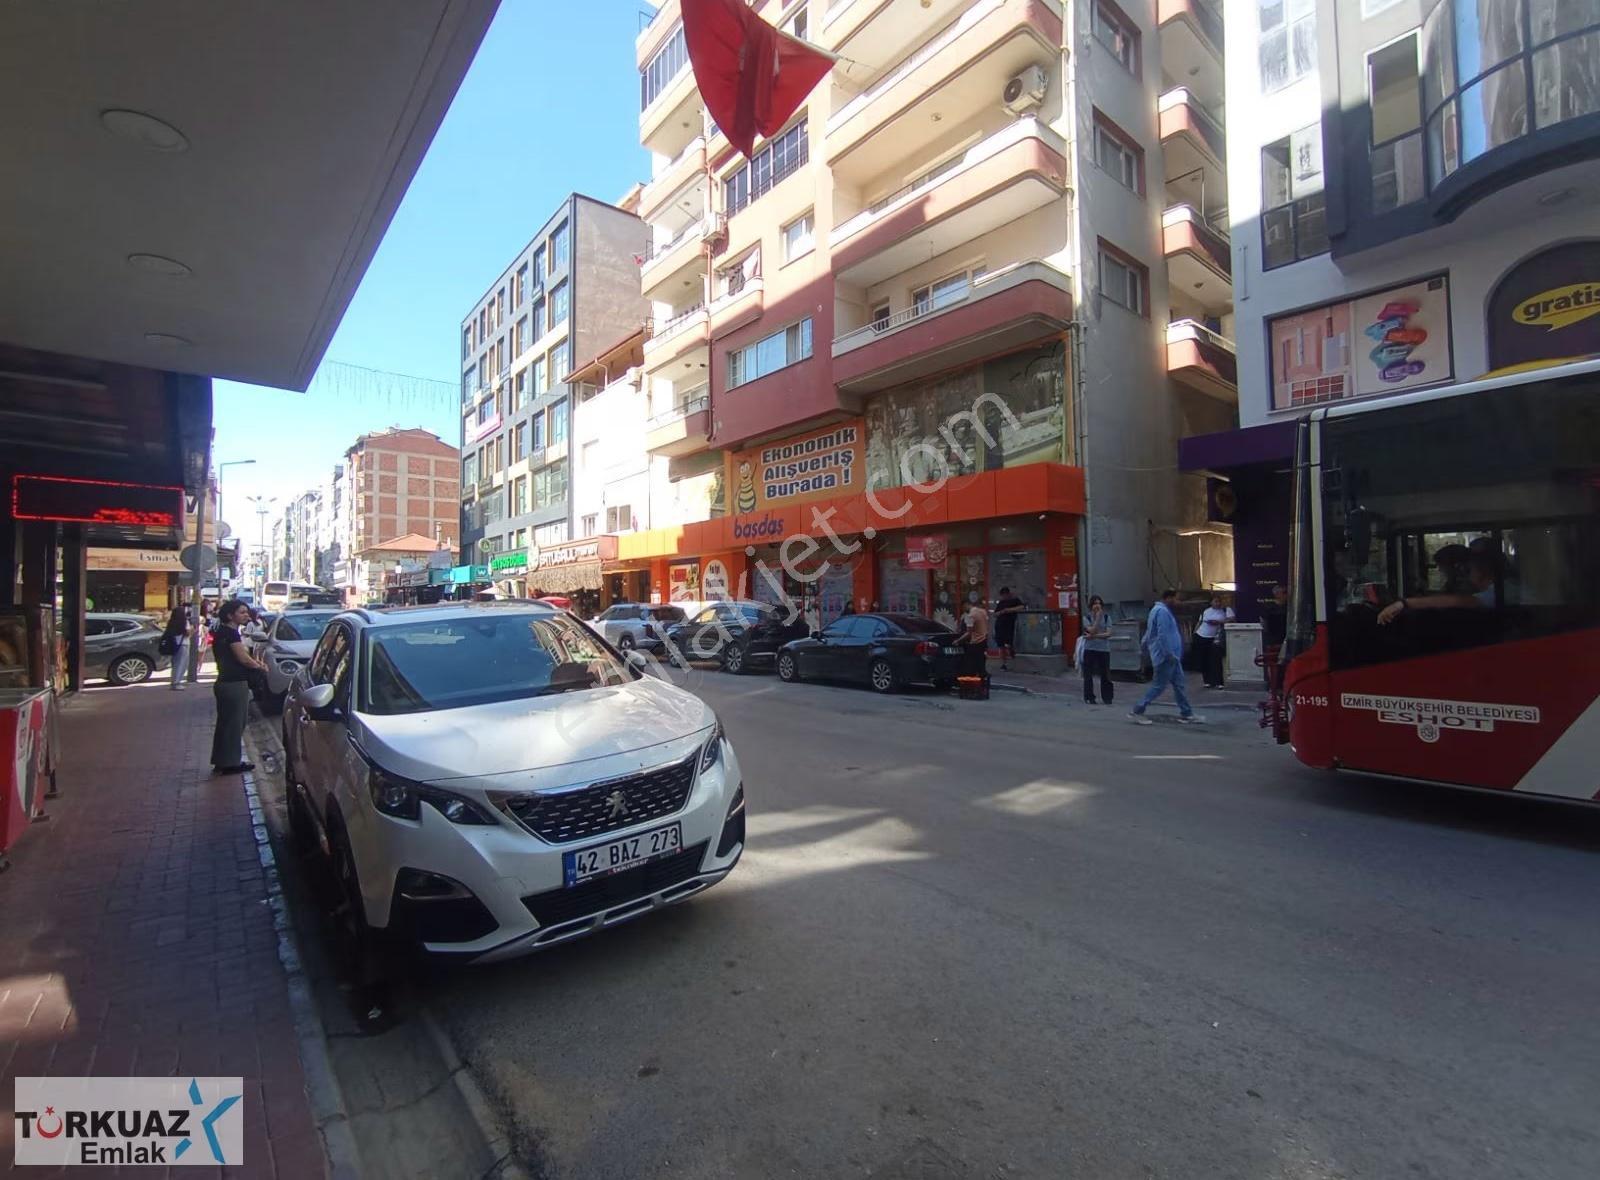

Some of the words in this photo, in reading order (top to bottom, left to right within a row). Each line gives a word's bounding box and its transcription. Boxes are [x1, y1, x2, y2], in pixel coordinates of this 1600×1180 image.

[766, 473, 837, 499] Burada
[1296, 695, 1328, 707] 21-195
[1343, 696, 1372, 708] İZMİR
[1457, 704, 1537, 721] BELEDİYESİ
[1380, 710, 1490, 729] ESHOT
[577, 851, 599, 874] 42
[610, 839, 641, 866] BAZ
[651, 827, 679, 853] 273
